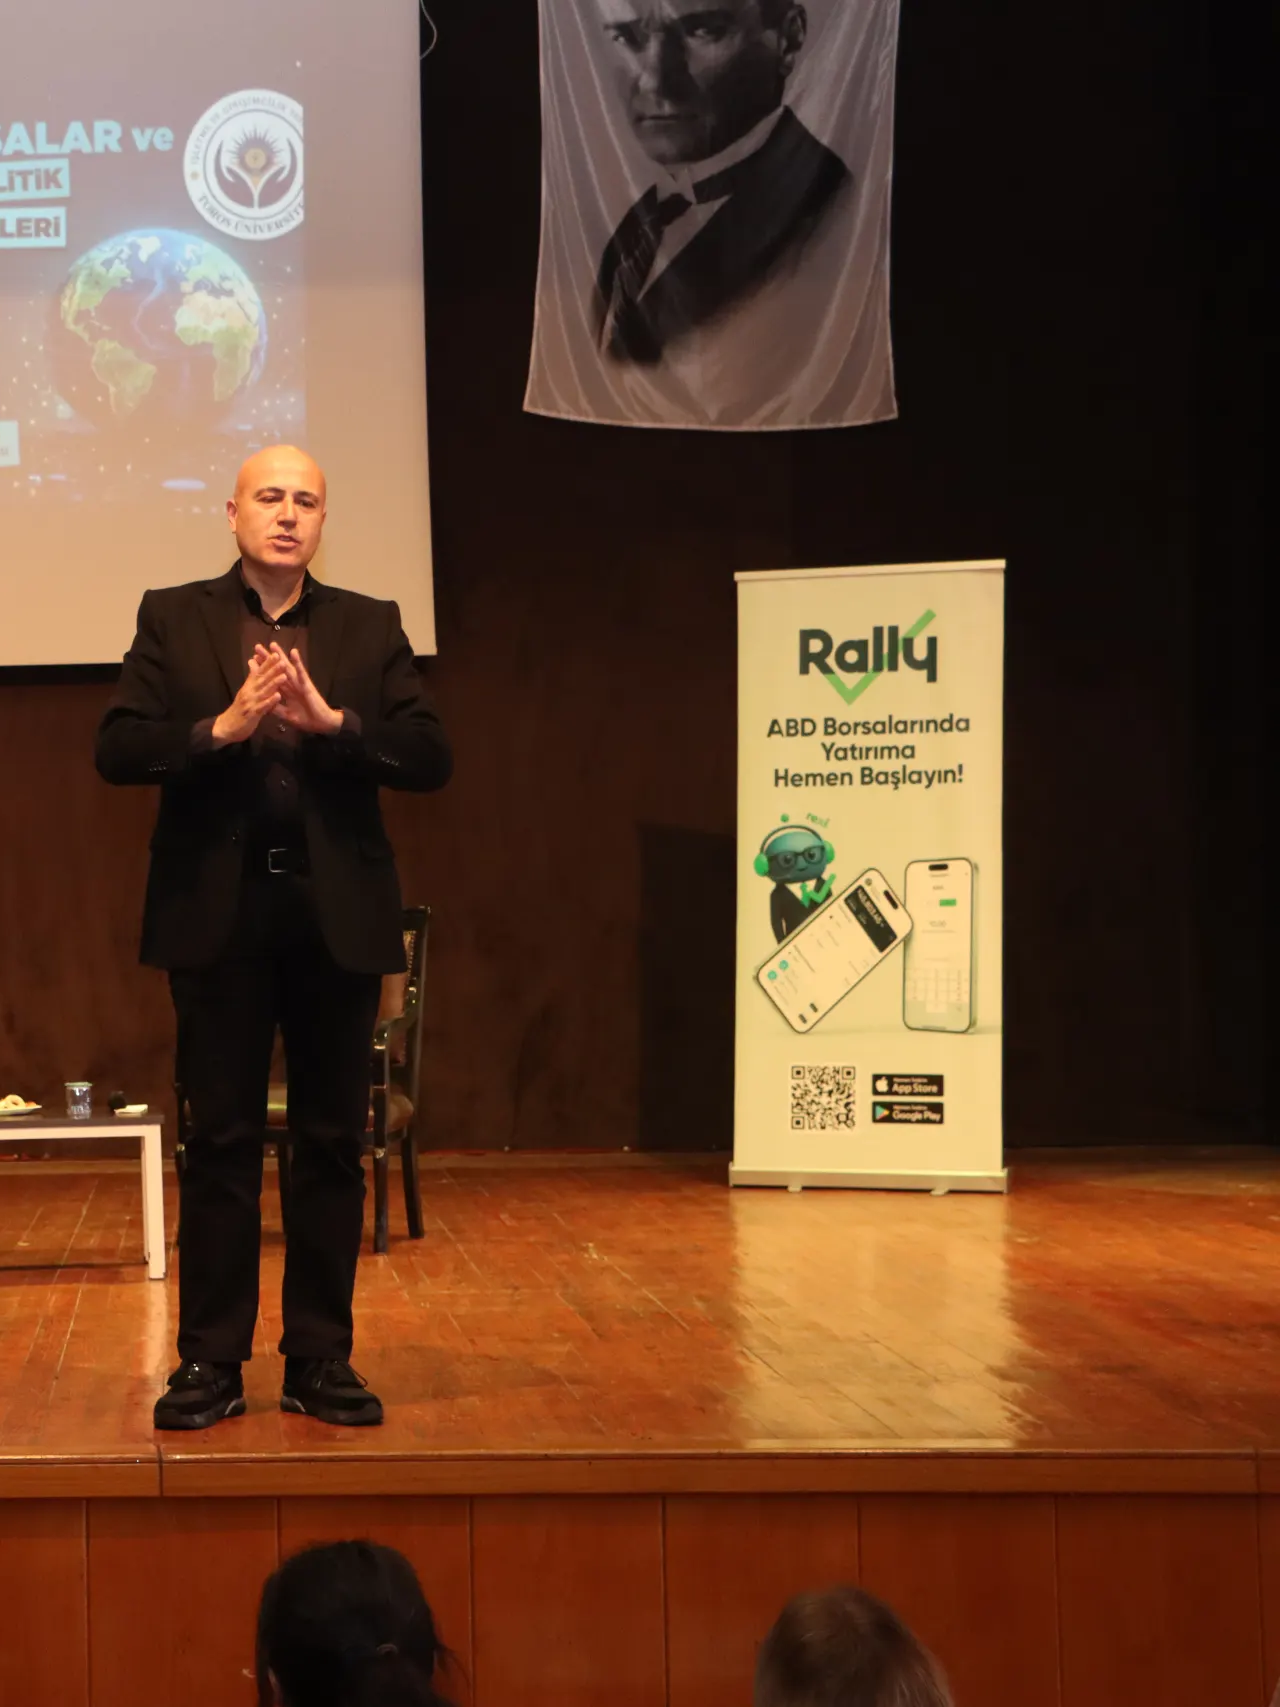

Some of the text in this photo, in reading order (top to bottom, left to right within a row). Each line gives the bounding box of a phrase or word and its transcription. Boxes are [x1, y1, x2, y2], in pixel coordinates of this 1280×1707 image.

[132, 125, 174, 151] ve
[799, 625, 938, 683] Rally
[767, 713, 970, 738] ABD Borsalarında
[821, 741, 916, 761] Yatırıma
[774, 763, 964, 790] Hemen Başlayın!
[892, 1082, 938, 1095] App Store
[892, 1110, 941, 1122] Google Play
